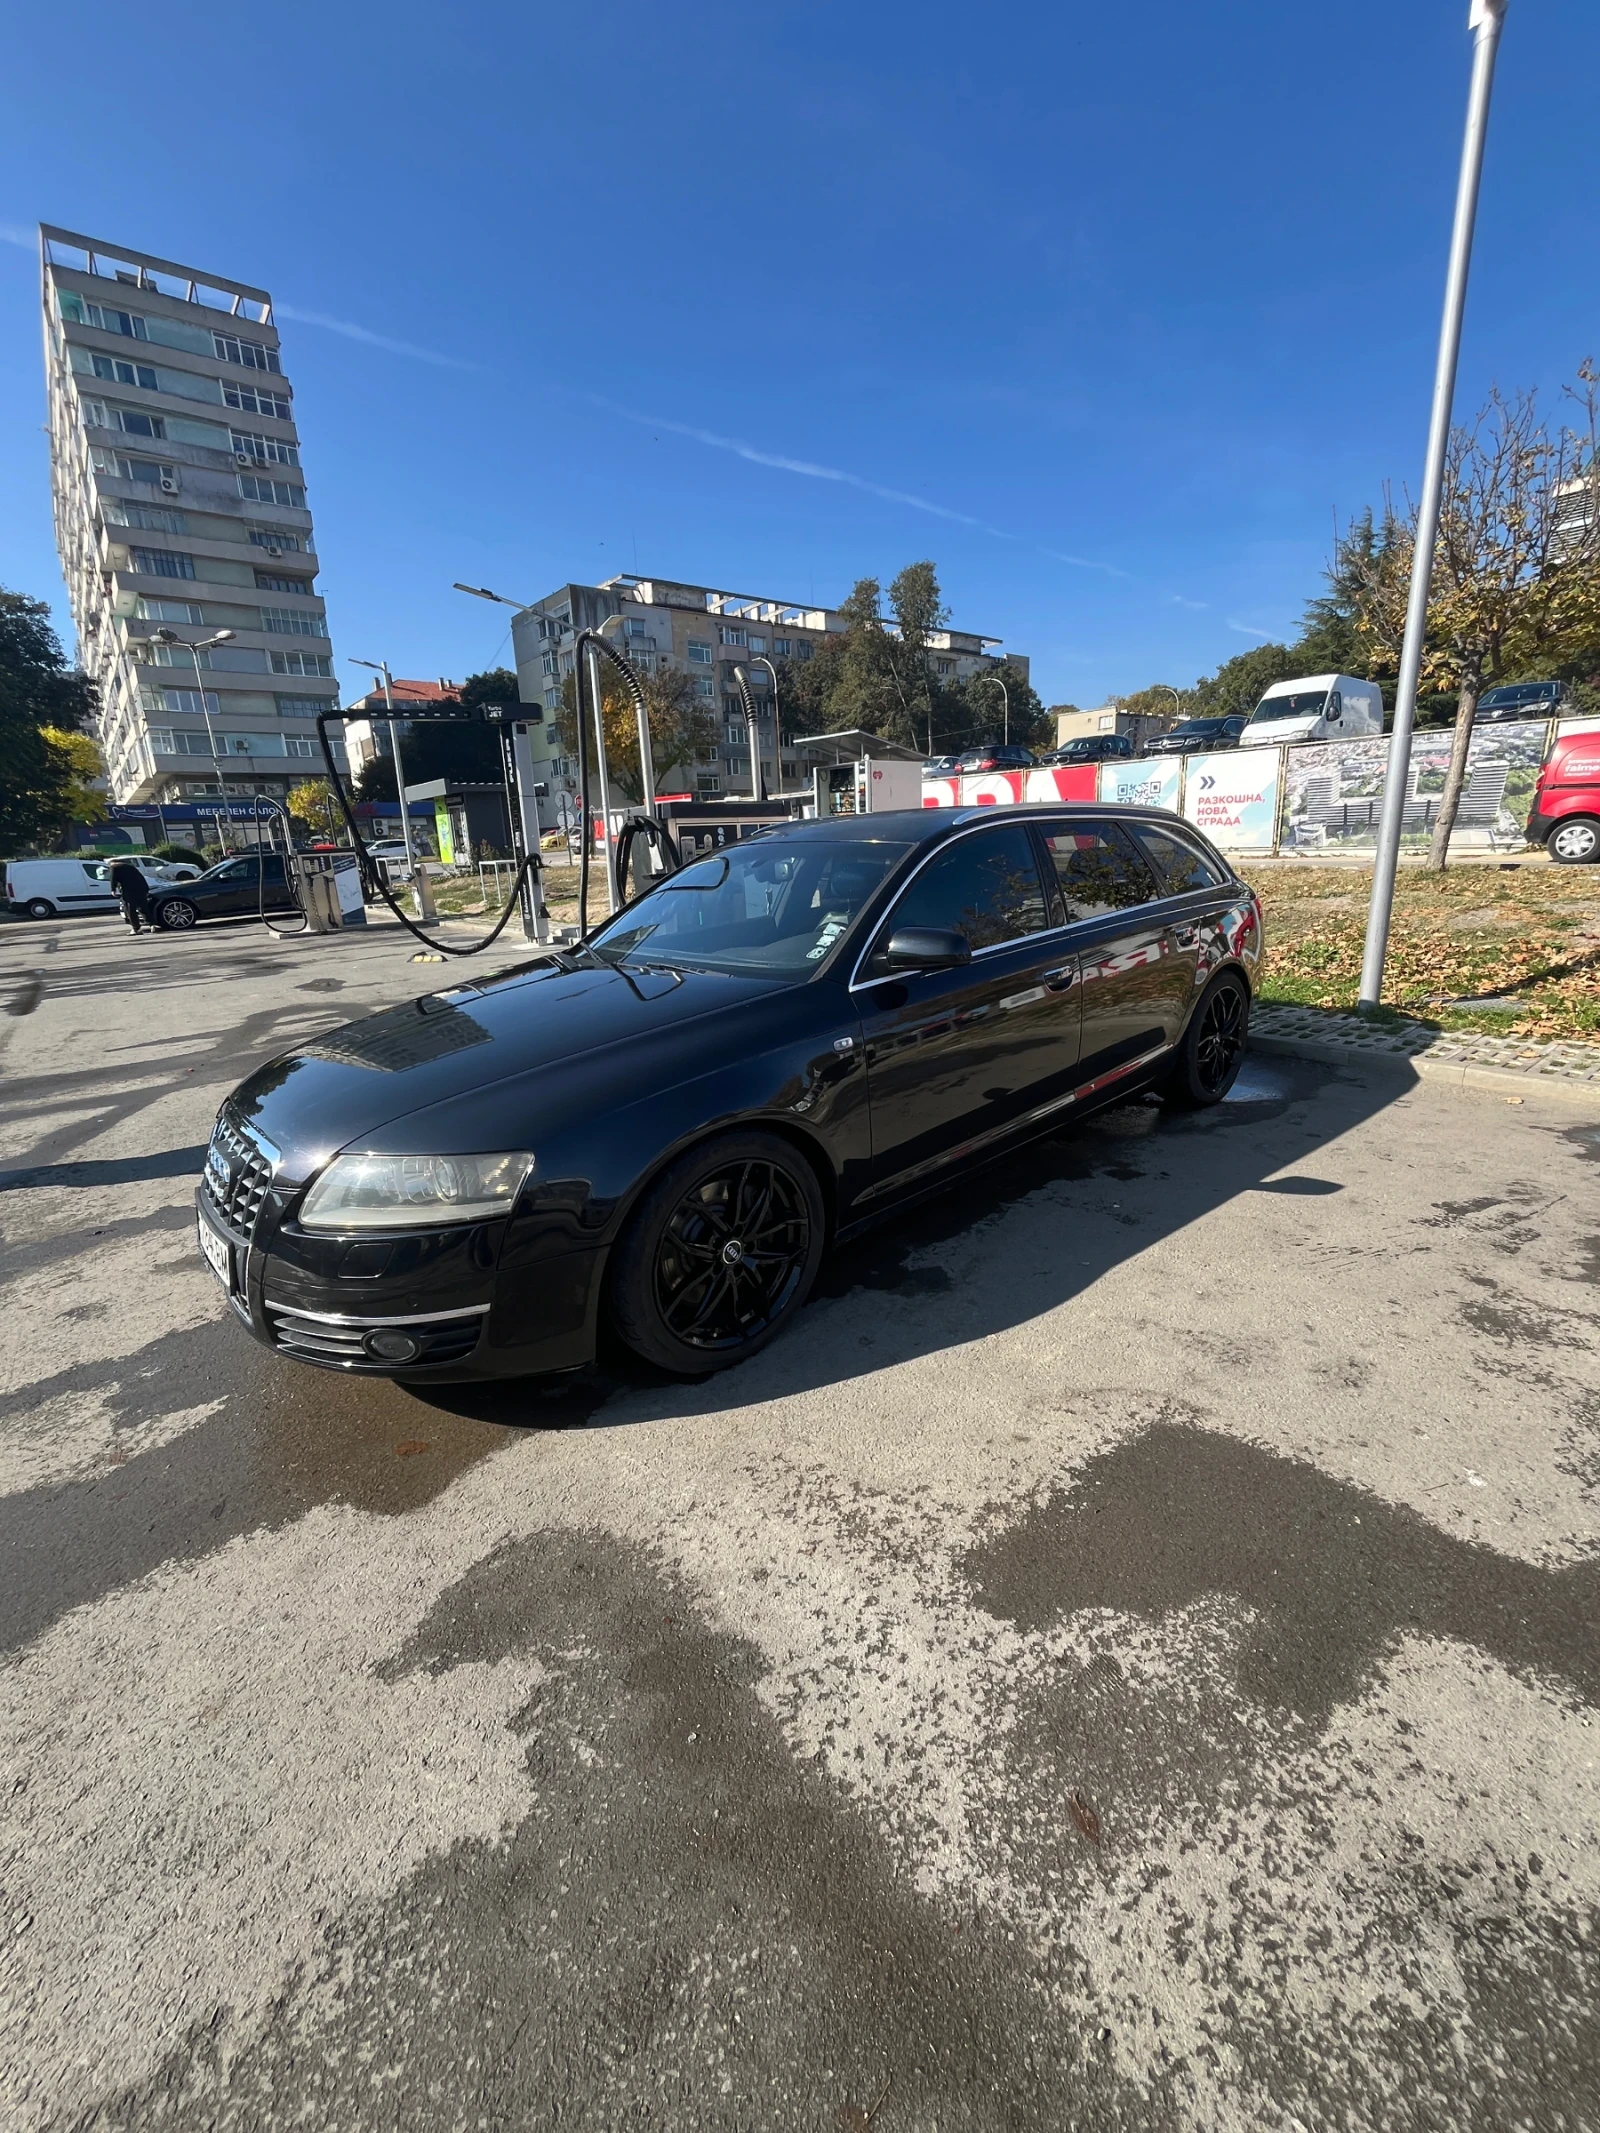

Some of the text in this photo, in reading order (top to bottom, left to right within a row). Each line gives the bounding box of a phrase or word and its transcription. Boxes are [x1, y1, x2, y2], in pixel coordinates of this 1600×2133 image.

[1198, 793, 1265, 805] РАЗКОШНА,
[197, 807, 246, 816] МЕБЕЛЕН
[1197, 806, 1228, 816] НОВА
[1196, 816, 1241, 826] СГРАДА
